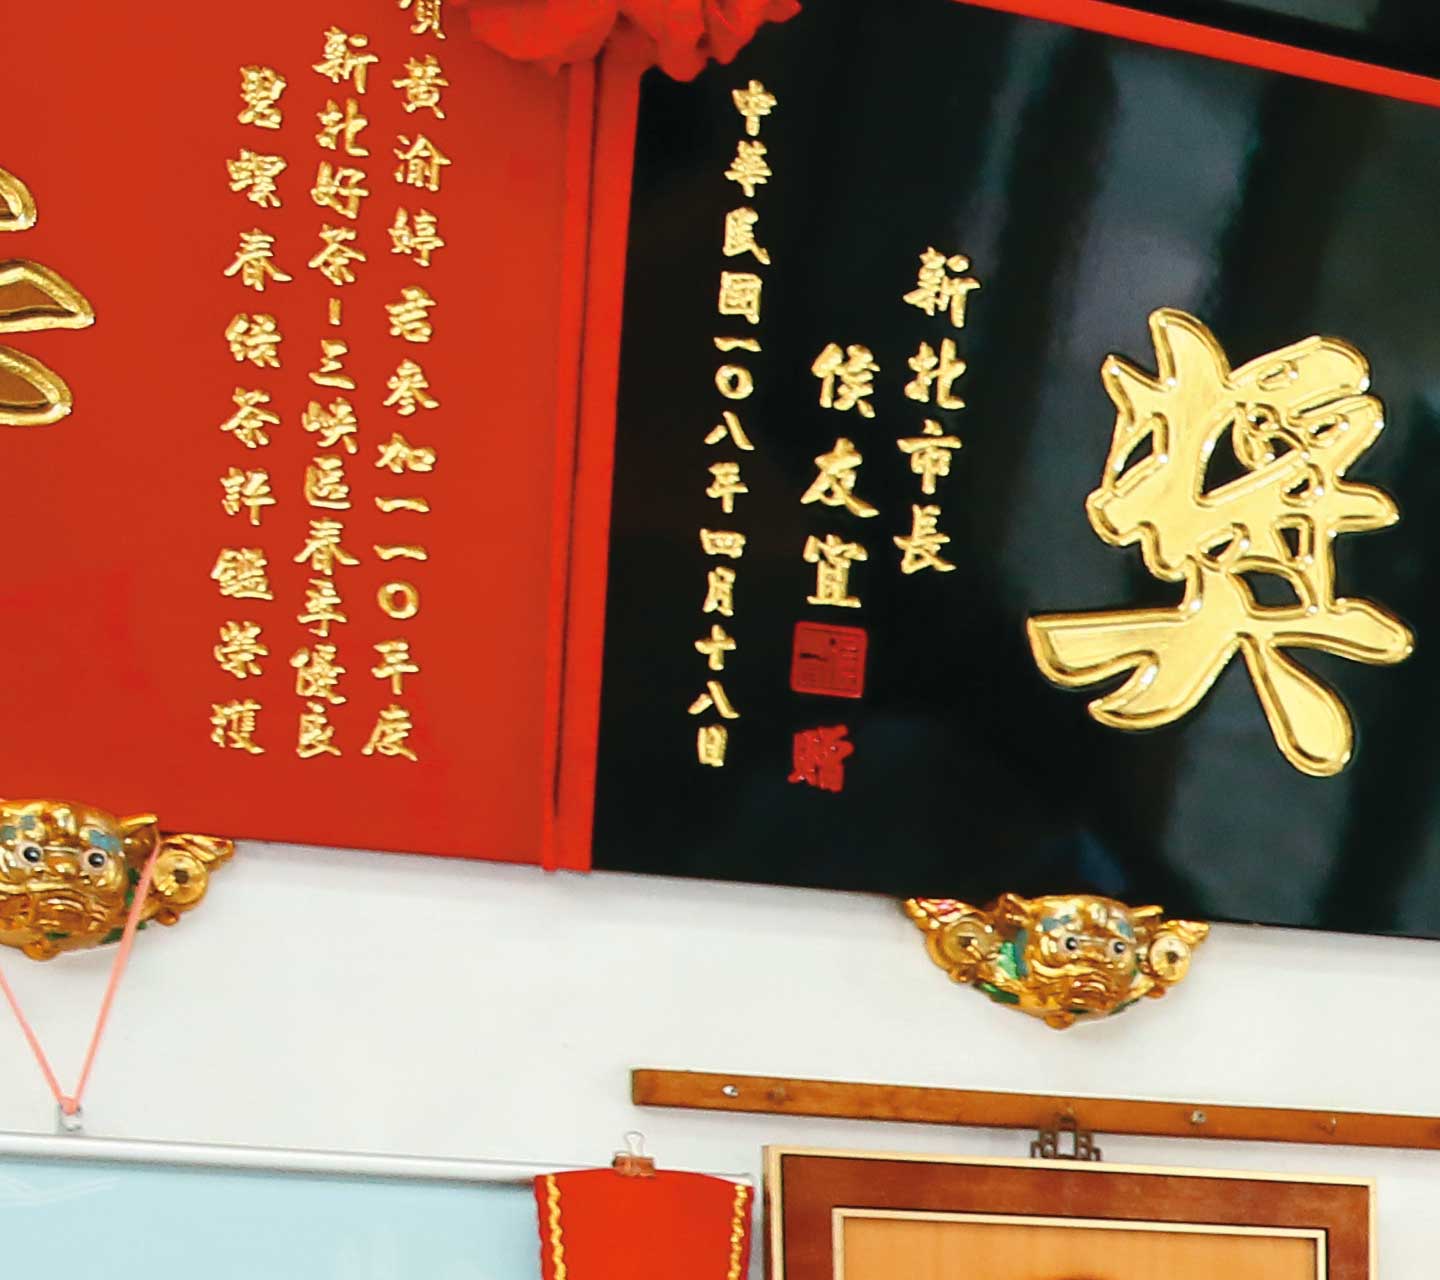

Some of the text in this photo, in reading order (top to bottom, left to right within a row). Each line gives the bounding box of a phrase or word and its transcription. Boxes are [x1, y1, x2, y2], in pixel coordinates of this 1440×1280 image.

[802, 341, 881, 608] 侯友宜
[893, 246, 980, 575] 新北市長
